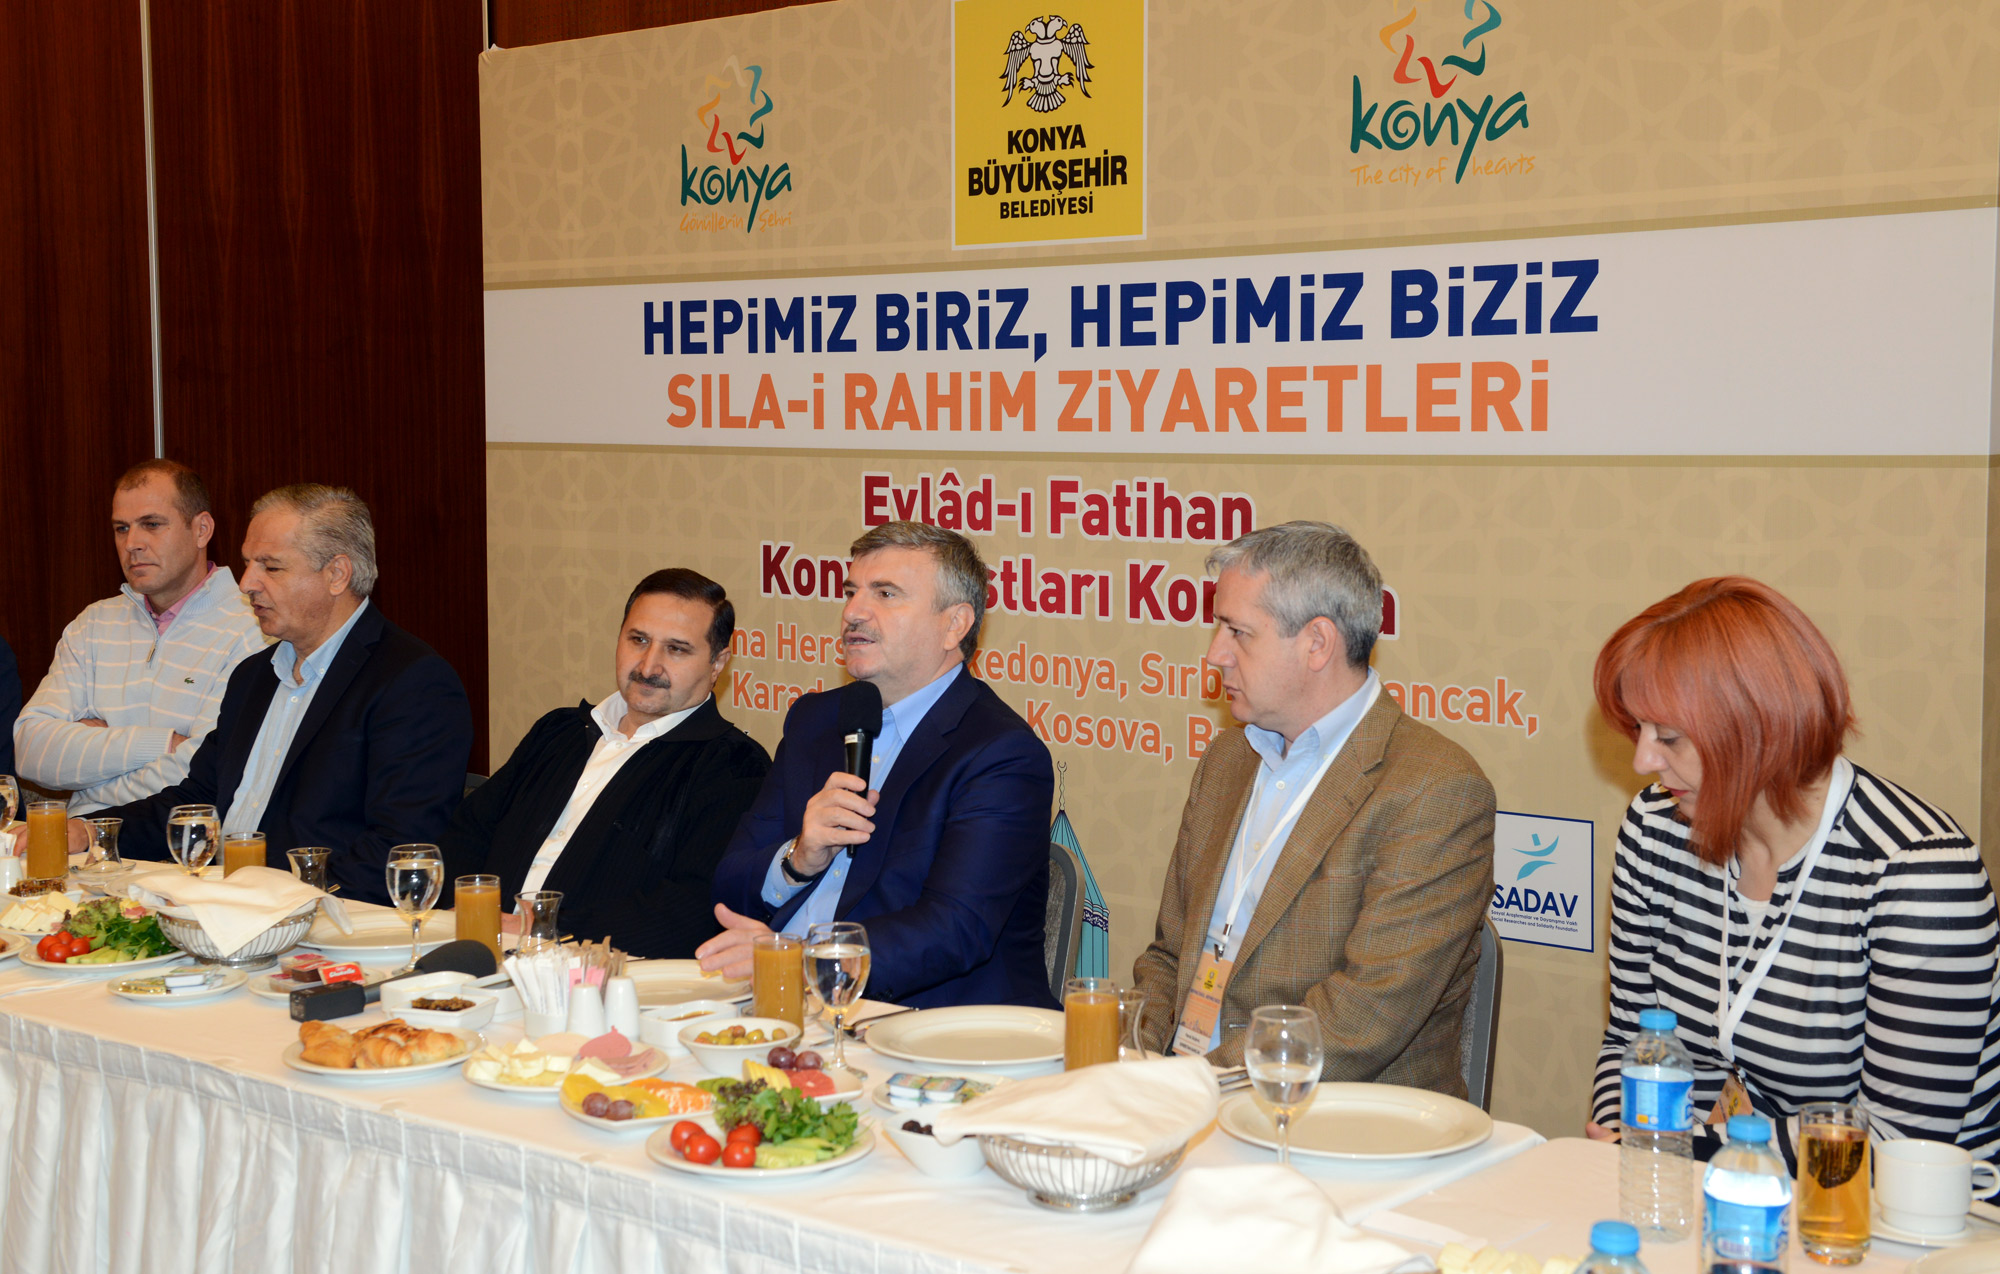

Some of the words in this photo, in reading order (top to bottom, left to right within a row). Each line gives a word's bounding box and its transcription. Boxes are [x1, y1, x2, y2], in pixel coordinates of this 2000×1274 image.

[1007, 124, 1087, 155] KONYA
[968, 149, 1128, 196] BÜYÜKŞEHİR
[1350, 164, 1383, 187] The
[1388, 163, 1421, 187] city
[1425, 156, 1449, 183] of
[1472, 153, 1536, 176] hearts
[679, 211, 744, 234] Gönüllerin
[758, 208, 792, 232] Şehri
[1000, 190, 1093, 219] BELEDİYESİ
[864, 472, 1031, 533] Evlâd-ı
[1050, 479, 1253, 541] Fatihan
[985, 557, 1110, 617] stları
[969, 642, 1127, 700] kedonya,
[1384, 678, 1538, 737] ancak,
[1027, 700, 1174, 765] Kosova,
[1492, 884, 1578, 918] SADAV
